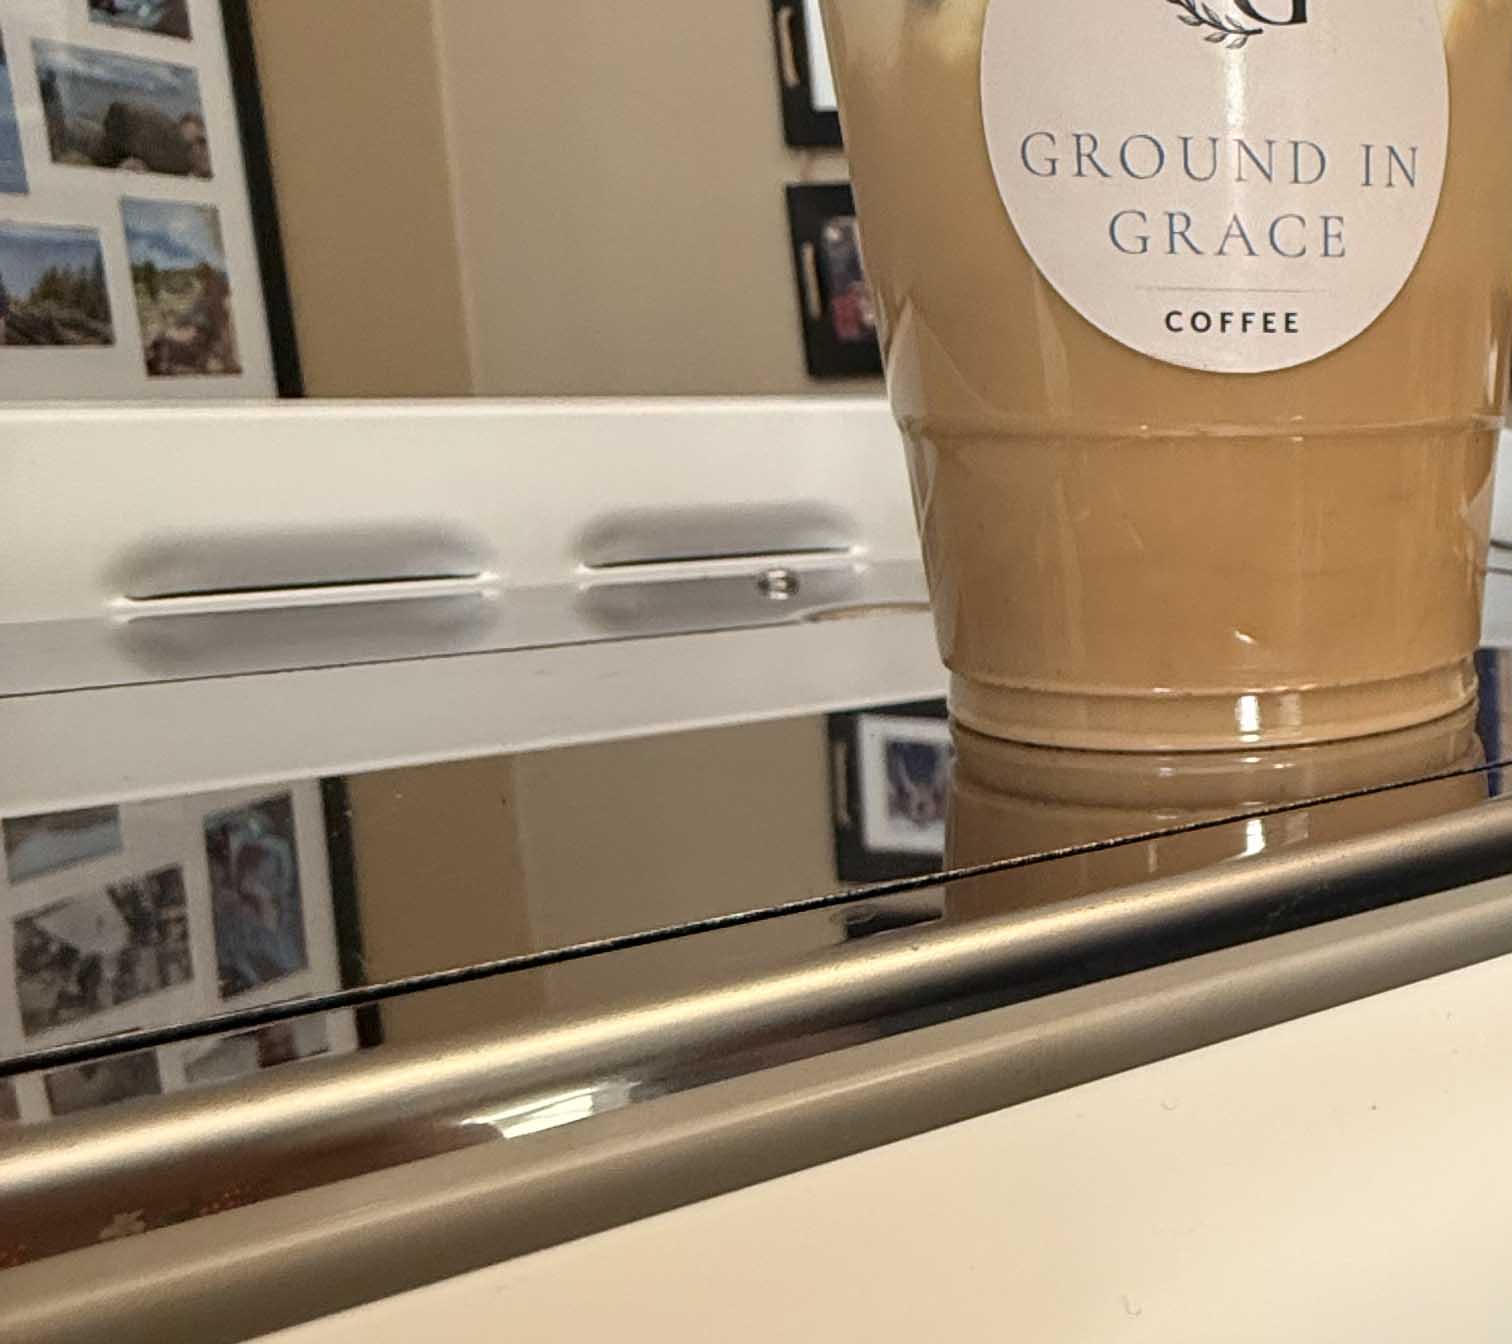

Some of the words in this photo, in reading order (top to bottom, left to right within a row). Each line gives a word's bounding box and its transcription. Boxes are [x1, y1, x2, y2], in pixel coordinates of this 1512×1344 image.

[1020, 131, 1328, 185] GROUND
[1360, 143, 1418, 188] IN
[1108, 208, 1347, 258] GRACE
[1164, 309, 1300, 334] COFFEE
